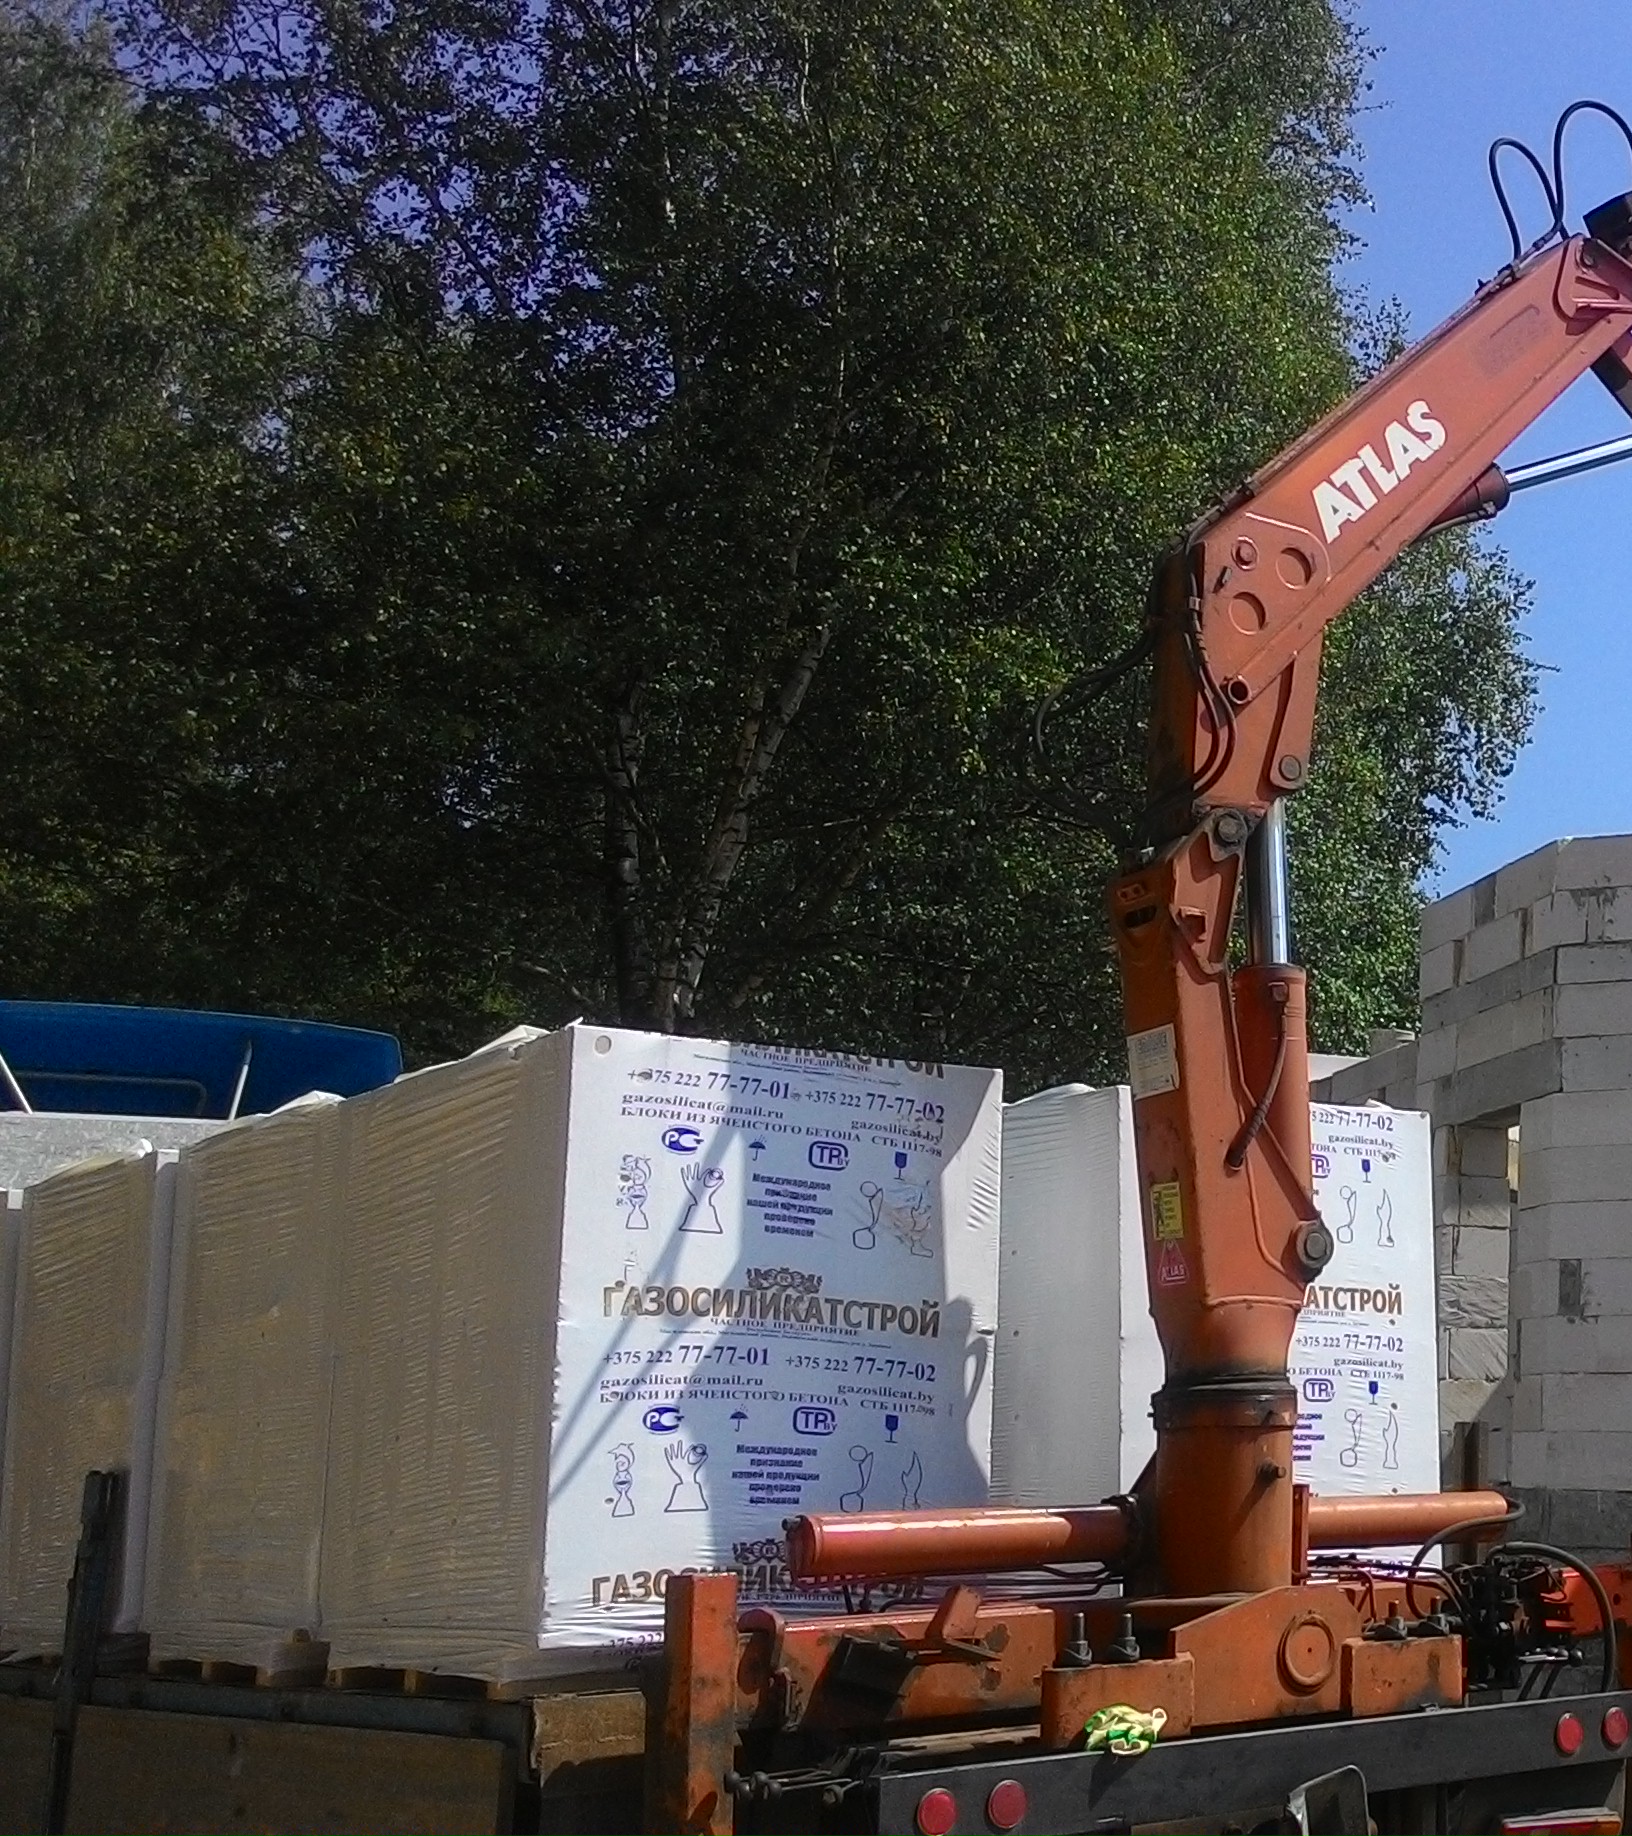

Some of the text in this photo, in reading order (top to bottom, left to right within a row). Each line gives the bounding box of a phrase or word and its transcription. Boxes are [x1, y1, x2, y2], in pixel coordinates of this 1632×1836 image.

[1312, 399, 1448, 544] ATLAS
[674, 1073, 701, 1087] 222
[707, 1072, 789, 1099] 77-77-01
[621, 1094, 784, 1119] gazosilicat@mail.ru
[805, 1091, 945, 1123] +375 222 77-77-02
[620, 1106, 681, 1122] БЛОКИ
[686, 1109, 706, 1122] ИЗ
[805, 1126, 861, 1143] БЕТОНА
[871, 1136, 898, 1148] СТБ
[1336, 1110, 1394, 1132] 77-77-02
[1343, 1146, 1363, 1156] СТБ
[1305, 1283, 1403, 1315] АТСТРОЙ
[603, 1284, 941, 1338] ГАЗОСИЛИКАТСТРОЙ
[1296, 1333, 1404, 1353] +375 222 77-77-02
[603, 1345, 769, 1366] +375 222 77-77-01
[785, 1355, 936, 1383] +375 222 77-77-02
[1299, 1367, 1343, 1377] БЕТОНА
[600, 1374, 763, 1390] gazosilicat@mail.ru
[664, 1389, 684, 1400] ИЗ
[788, 1393, 849, 1407] БЕТОНА
[860, 1400, 889, 1411] СТБ
[837, 1384, 935, 1405] gazosilicat.by
